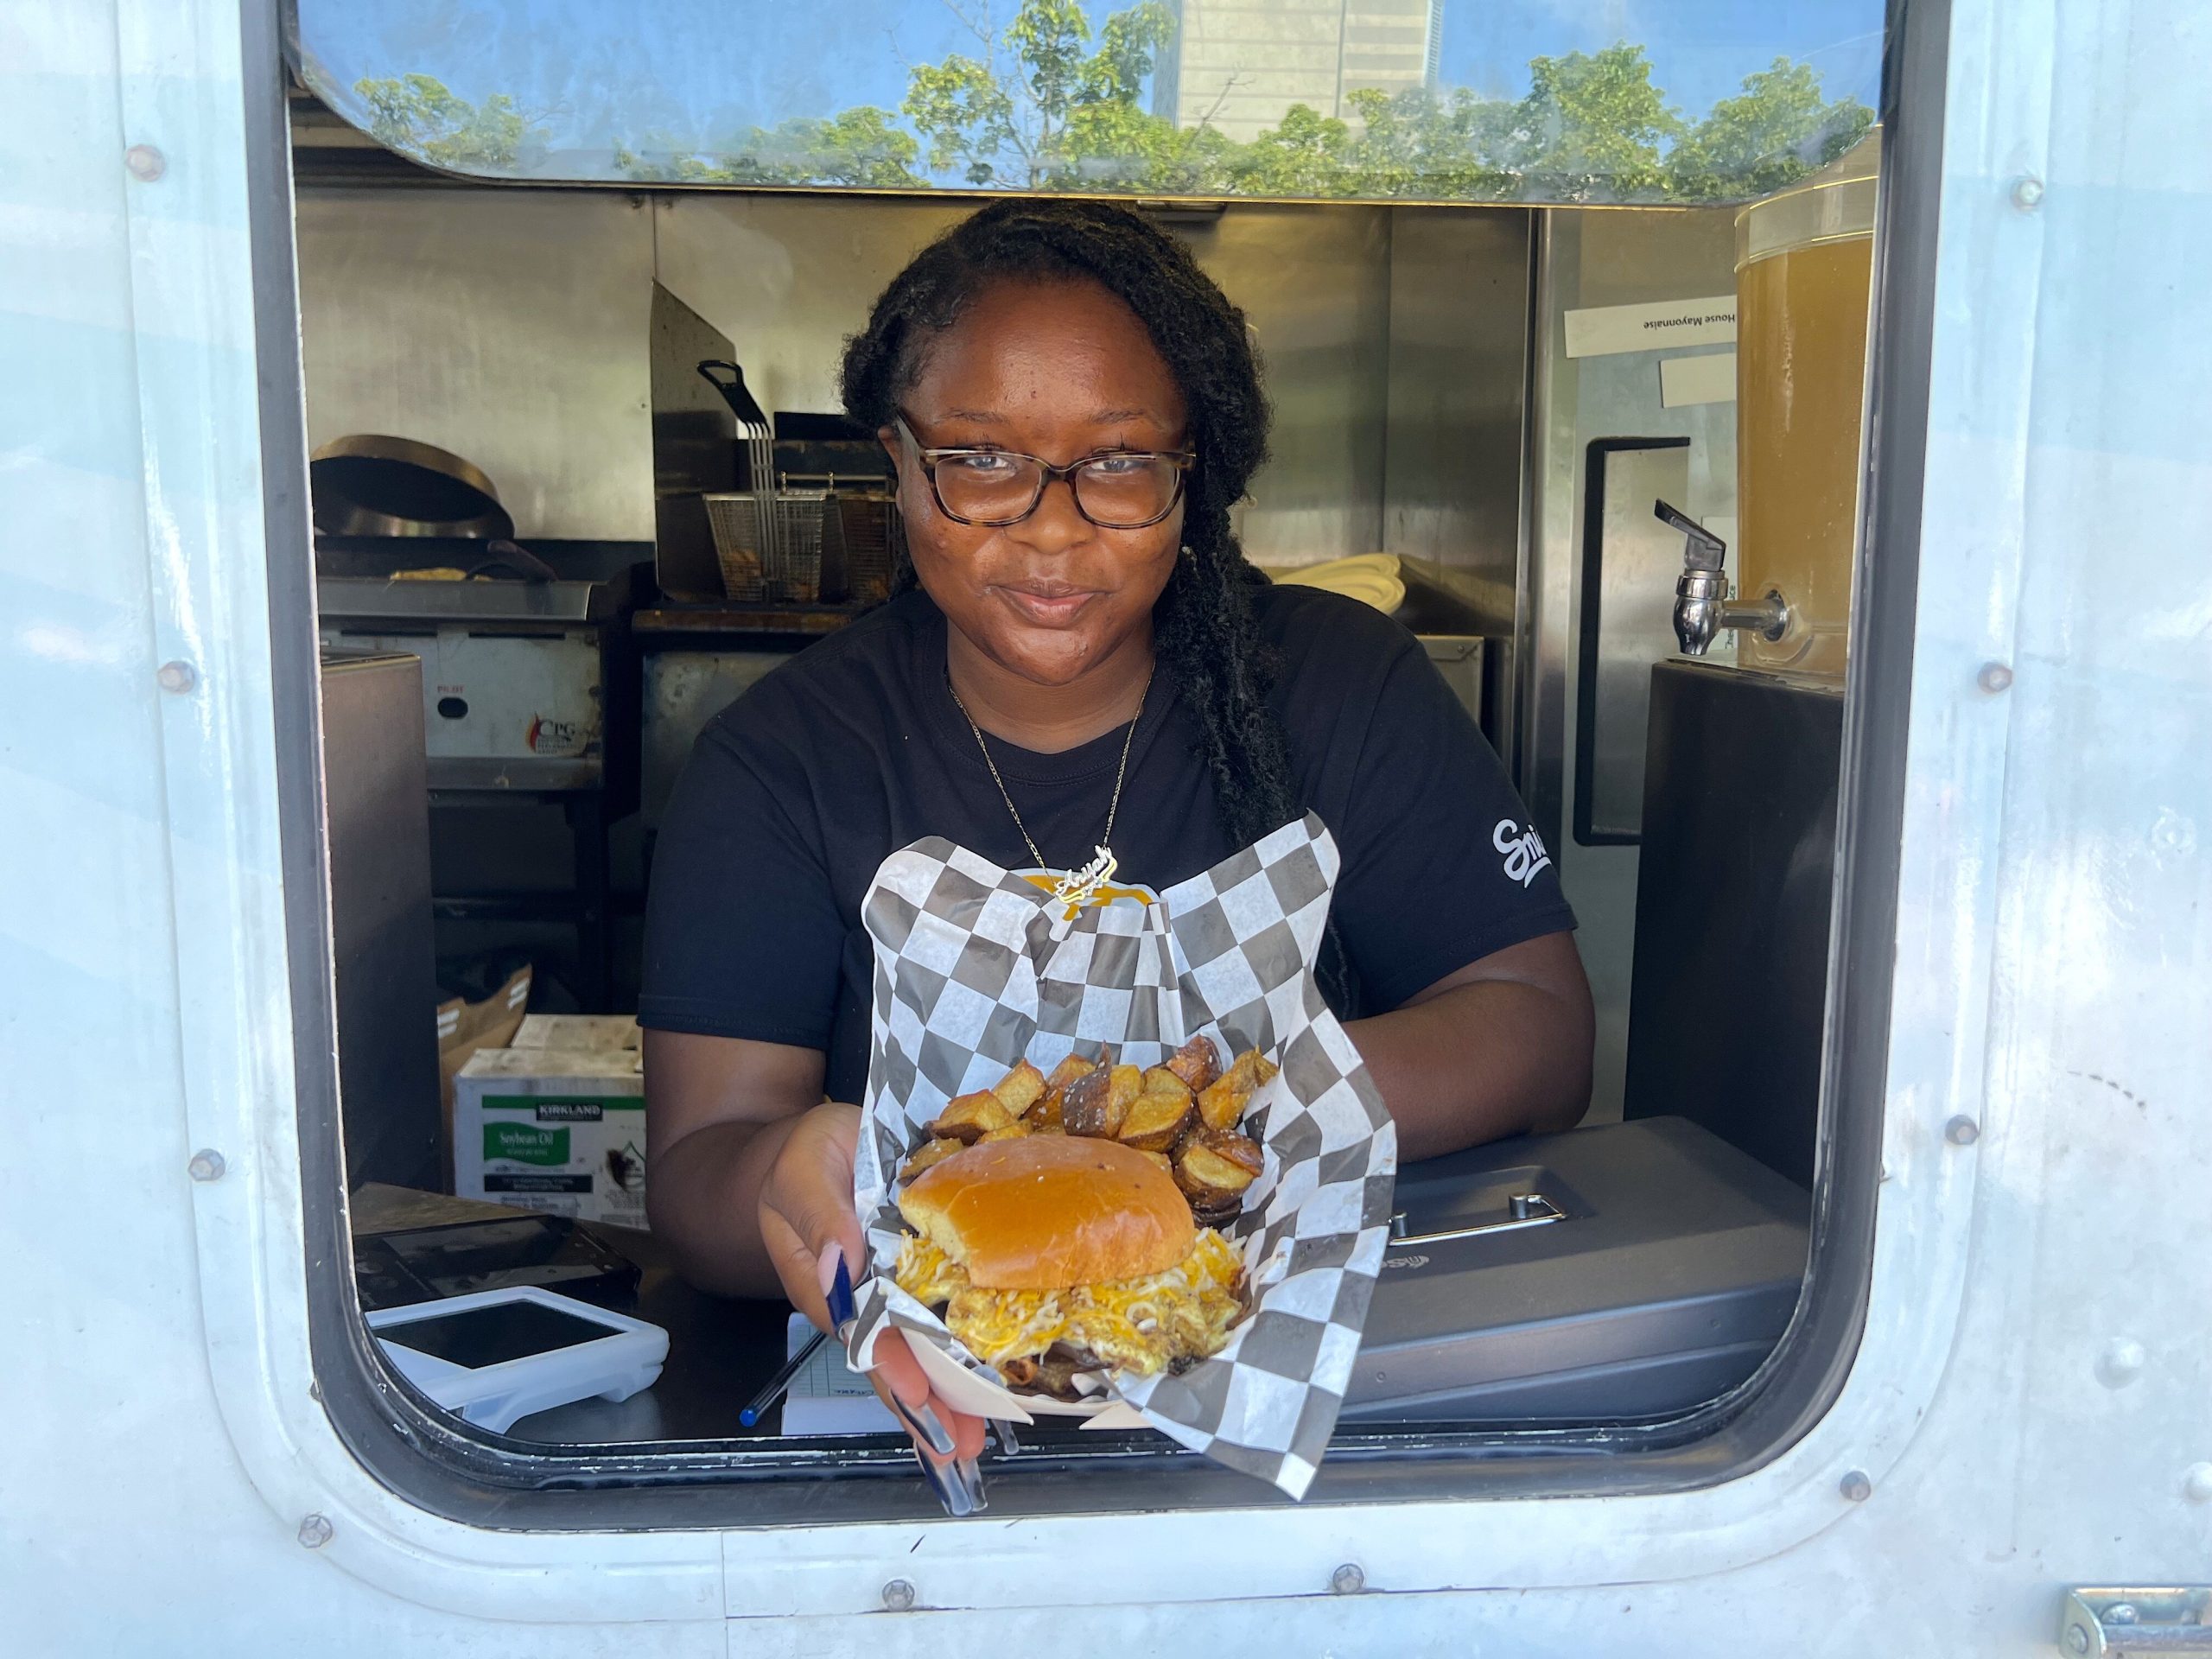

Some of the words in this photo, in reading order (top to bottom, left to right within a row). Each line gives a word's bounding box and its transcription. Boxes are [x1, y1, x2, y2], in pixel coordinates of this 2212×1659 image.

[1643, 316, 1702, 330] Mayonnaise
[1705, 314, 1735, 323] House
[538, 718, 575, 735] CPG
[538, 1104, 601, 1116] KIRKLAND
[499, 1132, 537, 1147] Soybean
[538, 1131, 553, 1145] Oil
